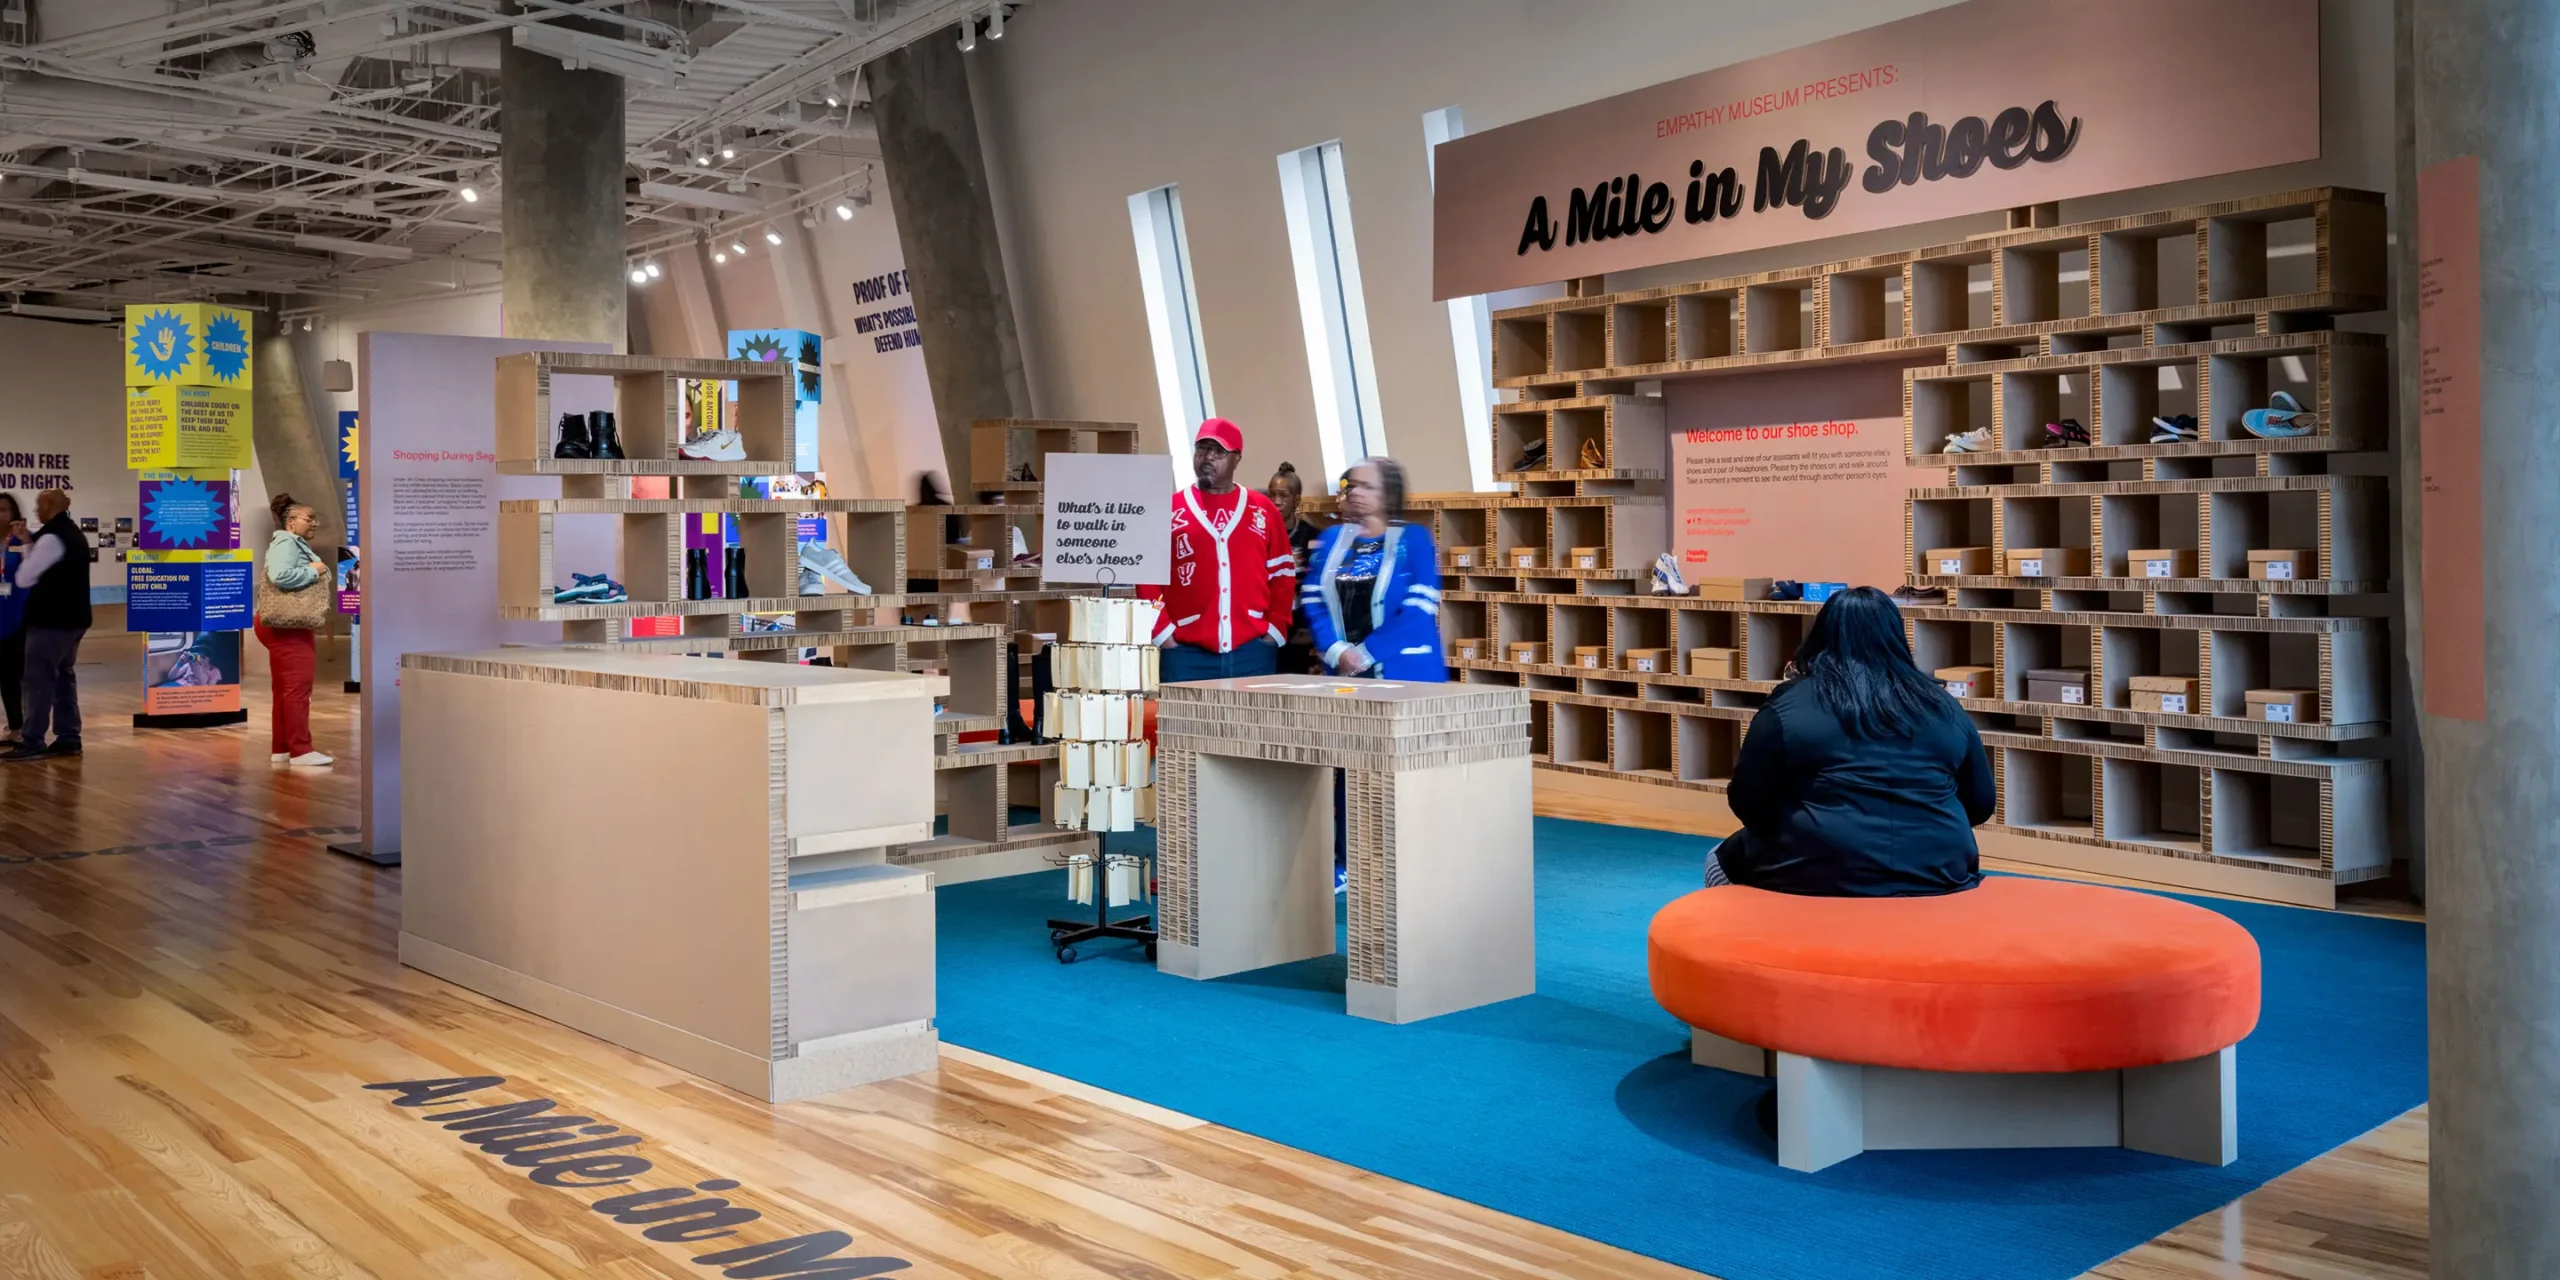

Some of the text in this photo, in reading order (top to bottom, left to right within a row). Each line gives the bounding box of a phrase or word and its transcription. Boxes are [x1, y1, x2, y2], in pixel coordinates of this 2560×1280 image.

[1657, 64, 1899, 138] EMPATHY MUSEUM PRESENTS:
[1517, 99, 2084, 257] A Mile in My Shoes
[852, 275, 887, 305] PROOF
[887, 271, 902, 296] OF
[854, 305, 917, 334] WHAT'S POSSIBL
[211, 341, 241, 353] CHILDREN
[874, 332, 903, 353] DEFEND
[706, 381, 714, 399] JOSE
[1686, 419, 1859, 443] Welcome to our shoe shop.
[39, 453, 70, 469] FREE
[393, 450, 439, 462] Shopping
[442, 451, 474, 463] During
[1704, 456, 1715, 464] take
[1819, 452, 1830, 461] you
[1831, 450, 1843, 458] with
[1844, 449, 1873, 458] someone
[1873, 448, 1890, 457] else's
[1686, 467, 1701, 475] shoes
[1702, 466, 1713, 474] and
[1717, 466, 1728, 475] pair
[1770, 463, 1789, 471] Please
[1790, 463, 1798, 473] try
[1799, 463, 1809, 471] the
[1810, 462, 1827, 470] shoes
[1838, 461, 1850, 469] and
[1851, 460, 1865, 468] walk
[21, 473, 73, 490] RIGHTS.
[1703, 476, 1726, 484] moment
[1730, 475, 1753, 483] moment
[1772, 474, 1781, 482] the
[1781, 474, 1798, 482] world
[1799, 473, 1821, 482] through
[1822, 472, 1845, 480] another
[1845, 471, 1871, 480] person's
[1057, 501, 1146, 515] What's it like
[1056, 518, 1127, 532] to walk in
[1056, 537, 1119, 549] someone
[1056, 552, 1143, 566] else's shoes?
[361, 1075, 507, 1107] A
[421, 1098, 653, 1188] Mile
[591, 1179, 761, 1243] in
